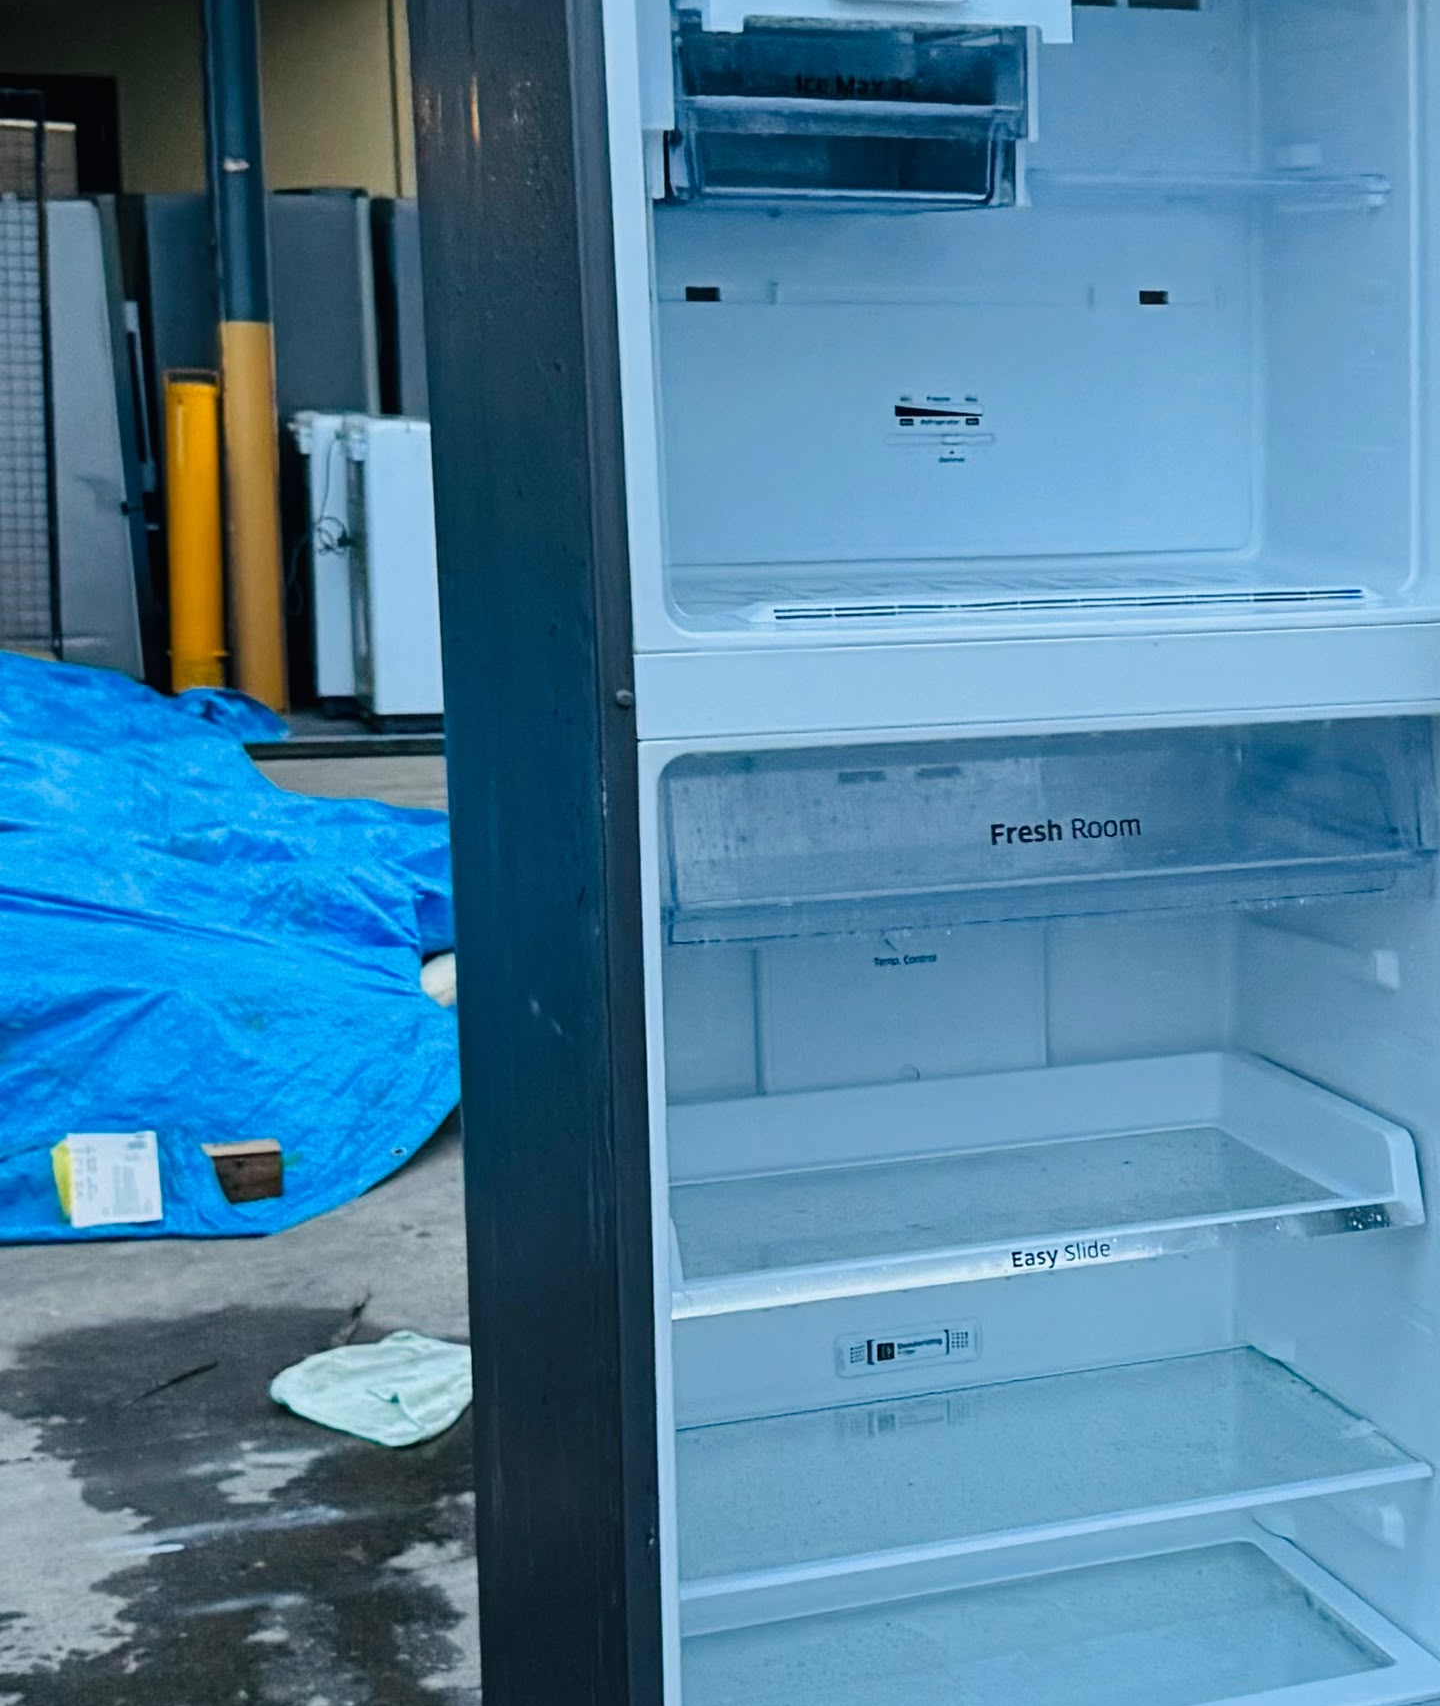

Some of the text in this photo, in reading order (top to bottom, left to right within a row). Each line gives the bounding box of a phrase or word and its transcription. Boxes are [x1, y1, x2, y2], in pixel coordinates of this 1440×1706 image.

[990, 817, 1142, 846] Fresh Room
[1011, 1240, 1111, 1269] Easy Slide
